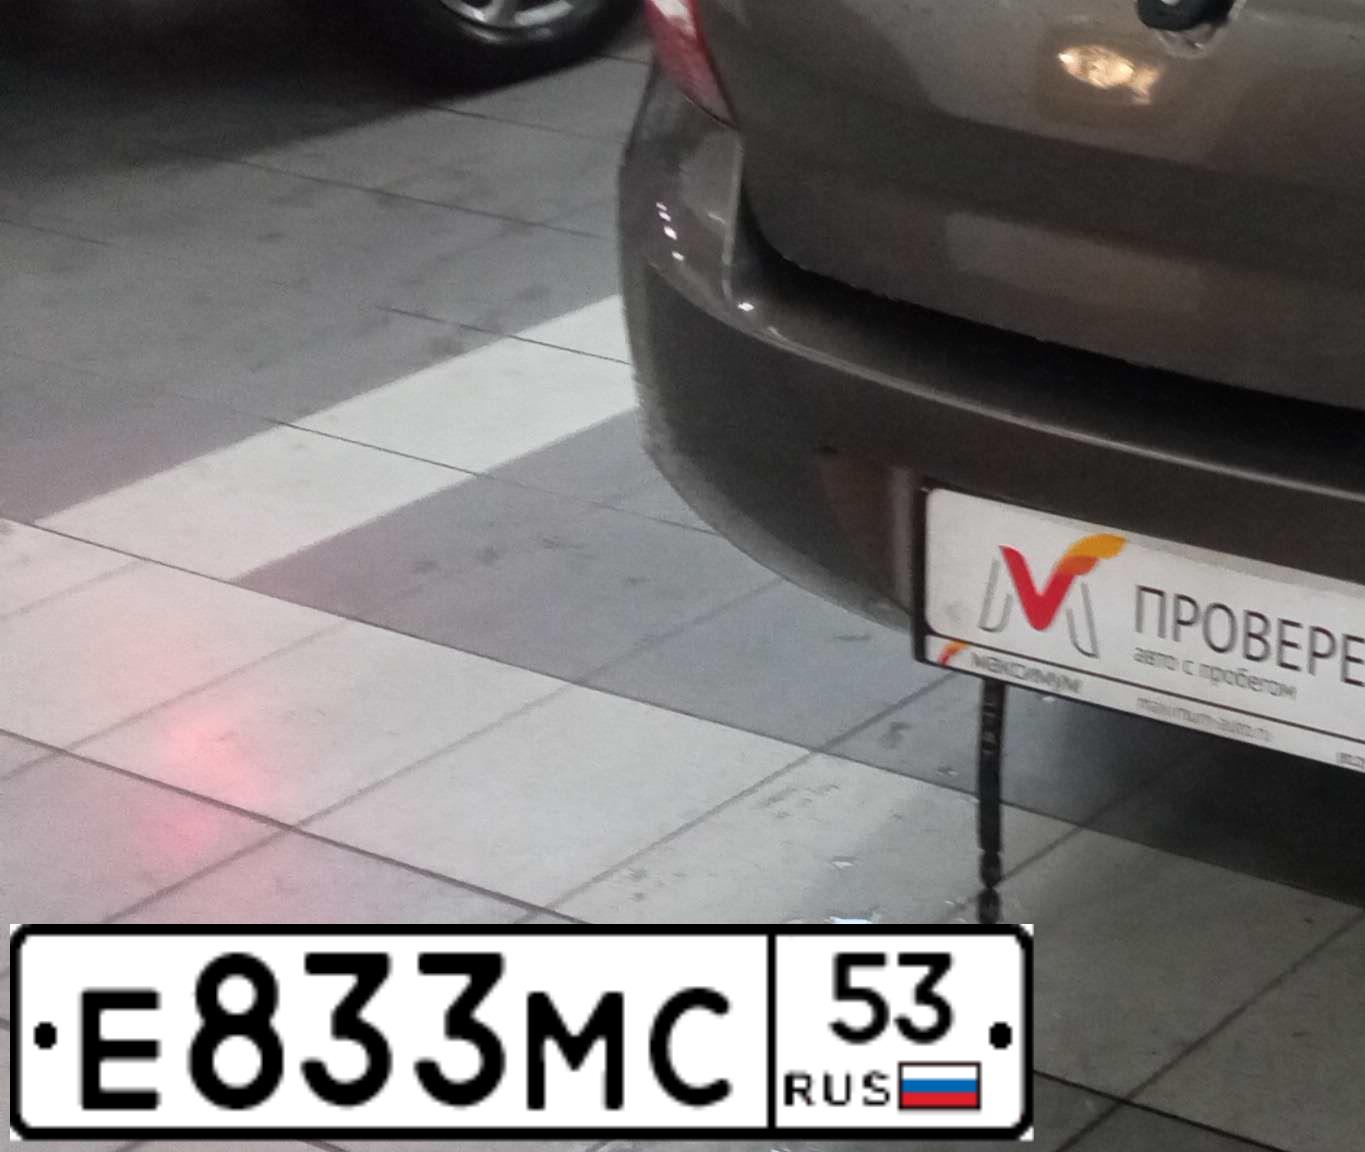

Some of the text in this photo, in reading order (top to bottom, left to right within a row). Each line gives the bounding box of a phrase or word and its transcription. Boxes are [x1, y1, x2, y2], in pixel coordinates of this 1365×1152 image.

[1133, 647, 1297, 700] авто с пробегом
